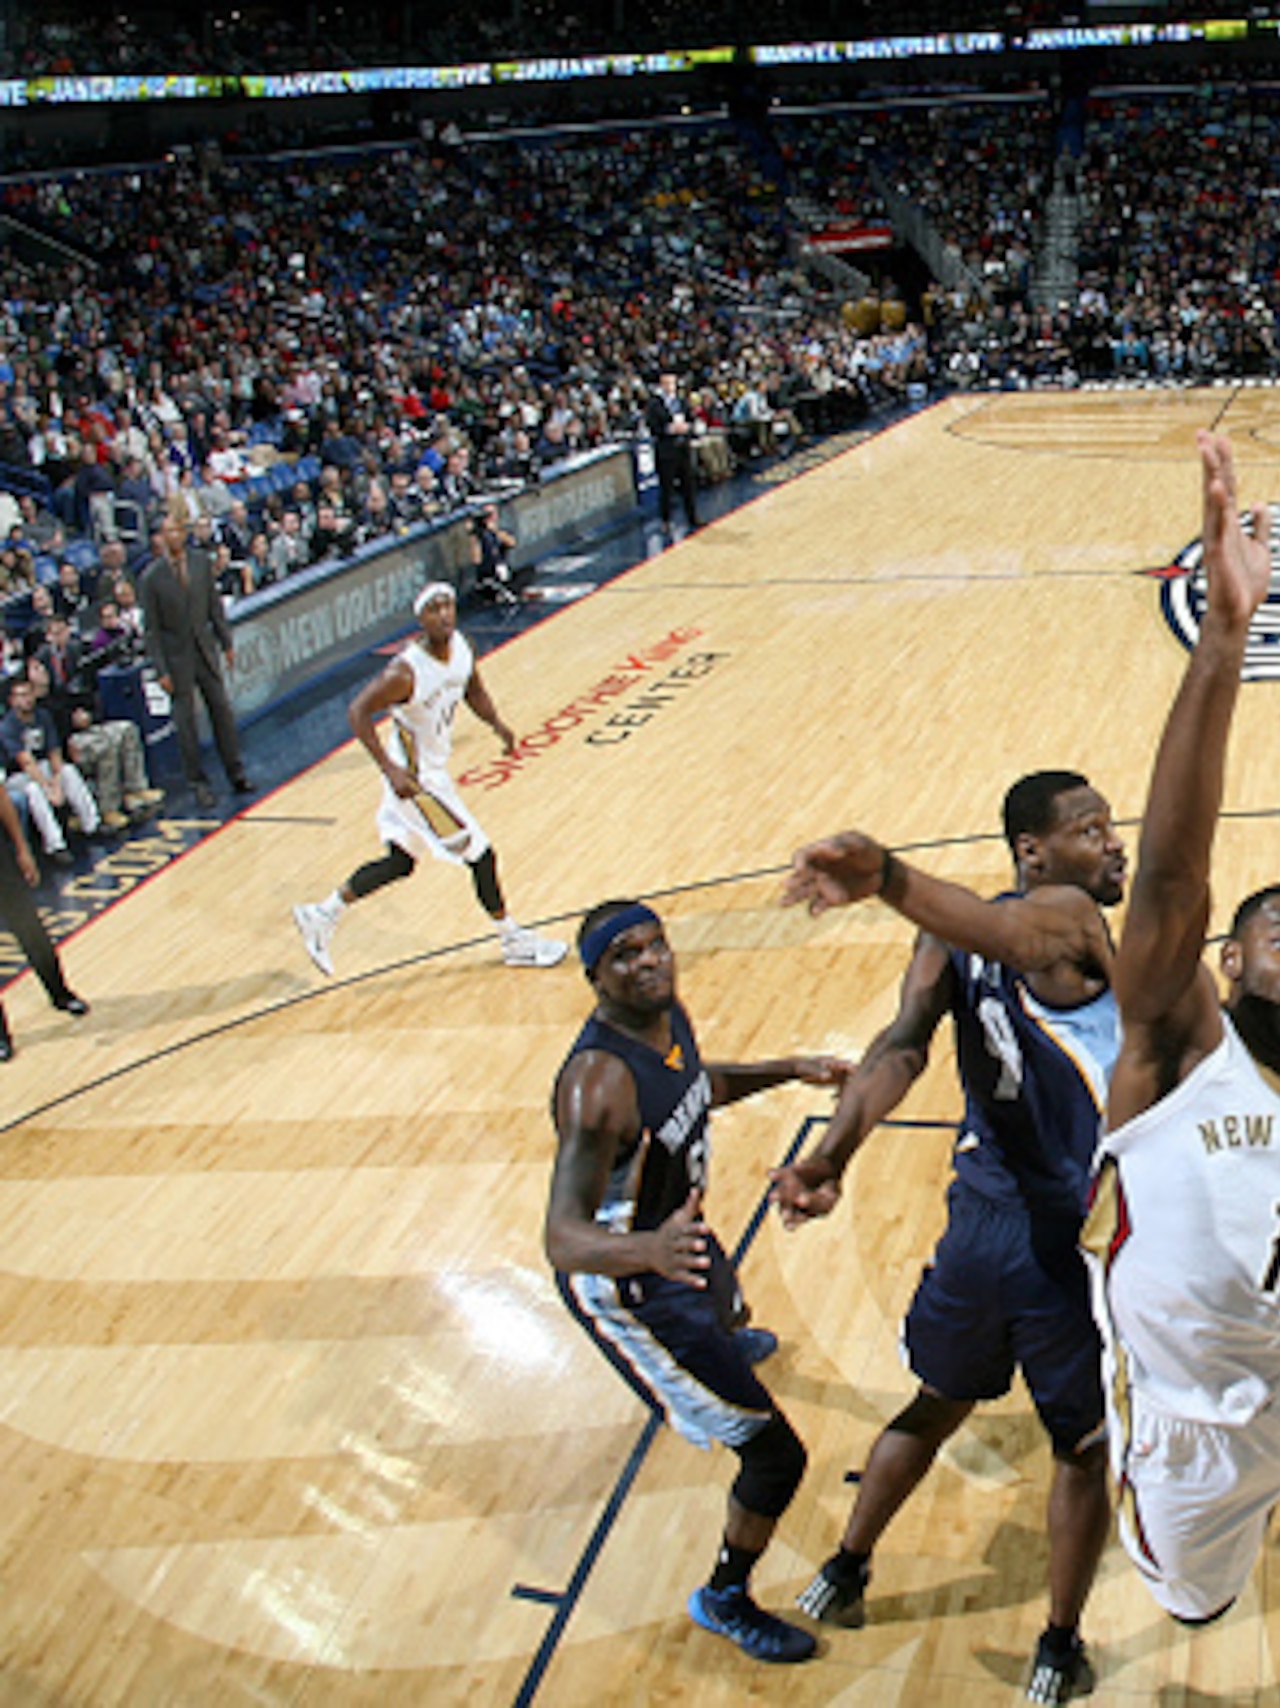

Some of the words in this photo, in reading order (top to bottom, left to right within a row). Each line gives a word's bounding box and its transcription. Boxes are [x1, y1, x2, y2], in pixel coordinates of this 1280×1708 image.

[278, 602, 336, 671] NEW
[336, 560, 426, 638] ORLEANS
[584, 652, 731, 745] CENTER
[1197, 1114, 1275, 1156] NEW
